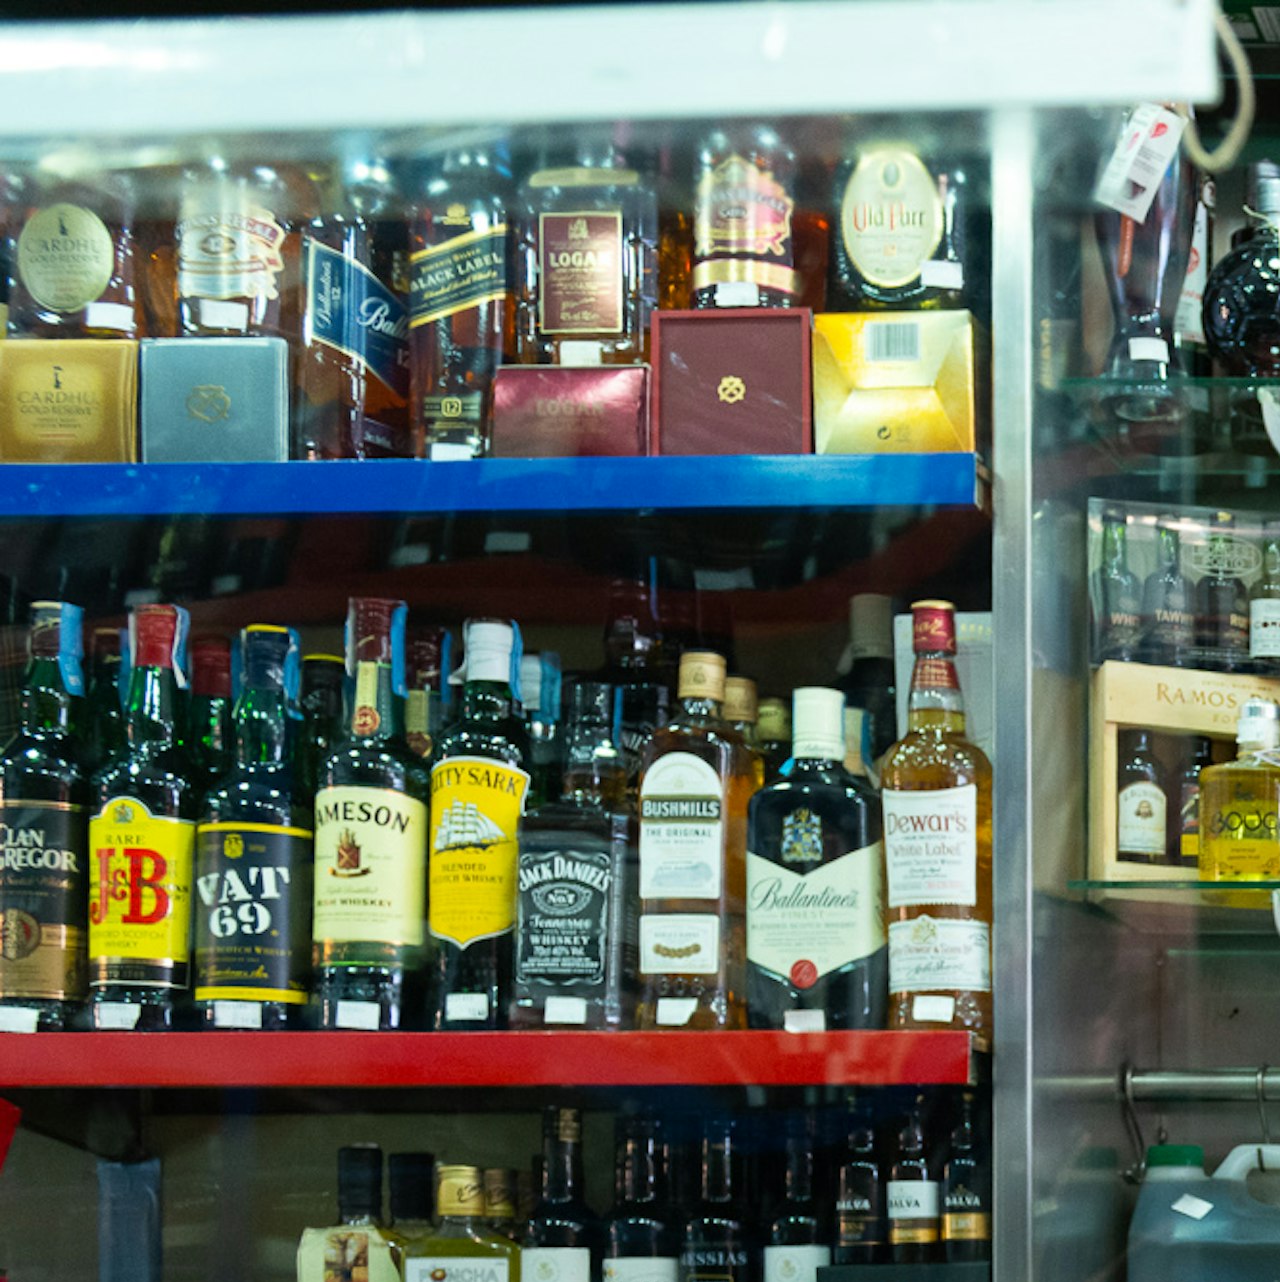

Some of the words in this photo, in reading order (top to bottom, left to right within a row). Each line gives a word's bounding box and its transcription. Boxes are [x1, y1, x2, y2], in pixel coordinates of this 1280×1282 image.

[549, 252, 612, 268] LOGAN
[411, 267, 455, 292] BLACK
[457, 251, 504, 274] LABEL
[1157, 682, 1237, 708] RAMOS
[467, 767, 520, 797] SARK
[642, 800, 721, 818] BUSHMILLS
[887, 811, 968, 836] Dewar's
[105, 834, 146, 845] RARE
[645, 828, 663, 838] THE
[666, 828, 712, 838] ORIGINAL
[519, 859, 553, 892] JACK
[553, 855, 613, 893] DANIEL'S
[196, 866, 291, 907] VAT
[528, 913, 593, 930] Tennessee
[780, 910, 825, 920] FINEST
[528, 934, 591, 946] WHISKEY
